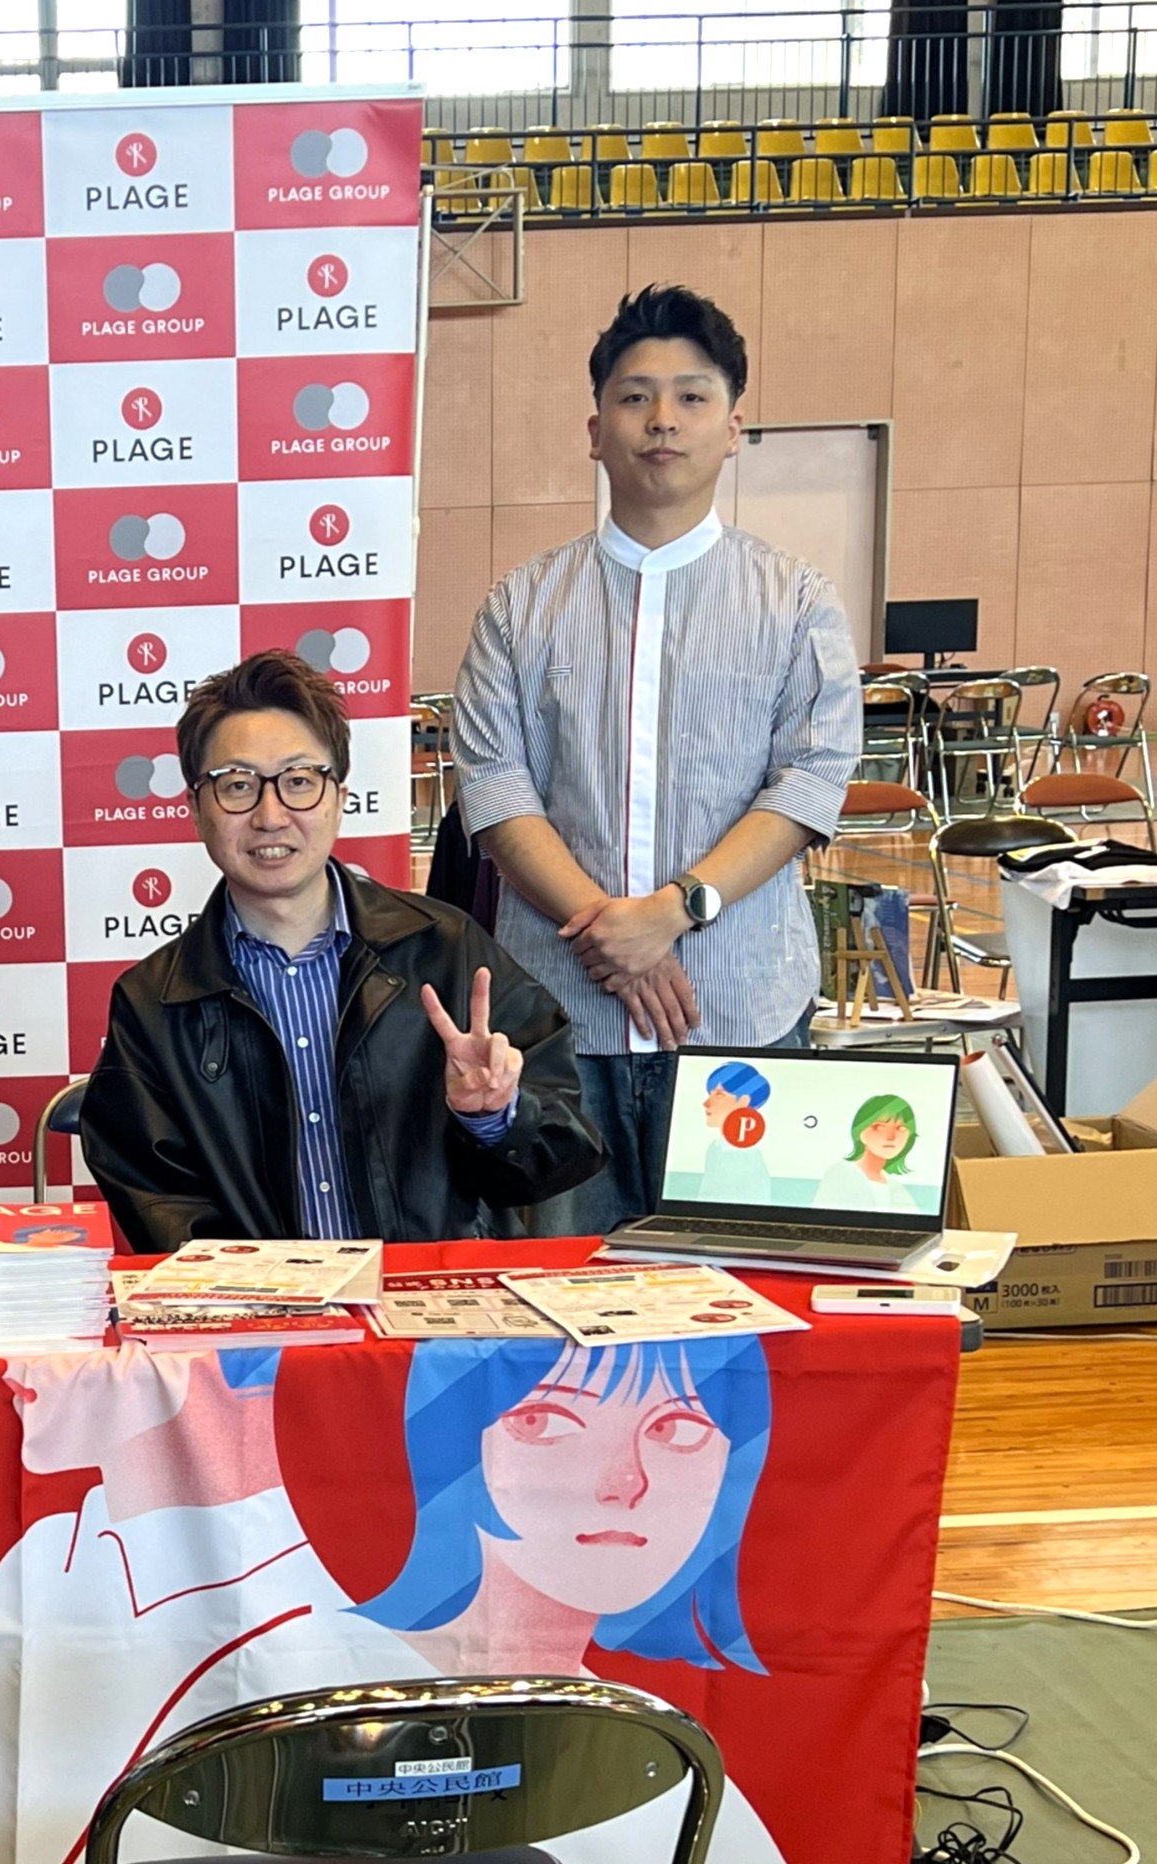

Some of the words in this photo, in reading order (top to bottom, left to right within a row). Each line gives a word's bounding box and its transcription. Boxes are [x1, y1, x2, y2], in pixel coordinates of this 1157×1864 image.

[86, 183, 188, 211] PLAGE
[268, 186, 323, 203] PLAGE
[328, 184, 390, 201] GROUP
[277, 304, 377, 331] PLAGE
[81, 320, 136, 336] PLAGE
[141, 318, 205, 335] GROUP
[93, 436, 193, 463] PLAGE
[271, 438, 325, 454] PLAGE
[330, 436, 391, 452] GROUP
[280, 552, 378, 579] PLAGE
[88, 568, 141, 584] PLAGE
[147, 566, 209, 582] GROUP
[333, 679, 391, 695] GROUP
[94, 807, 146, 822] PLAGE
[152, 804, 190, 820] GRO
[973, 1297, 990, 1311] M
[397, 1759, 470, 1775] 中央公民館
[346, 1771, 504, 1797] 中央公民館
